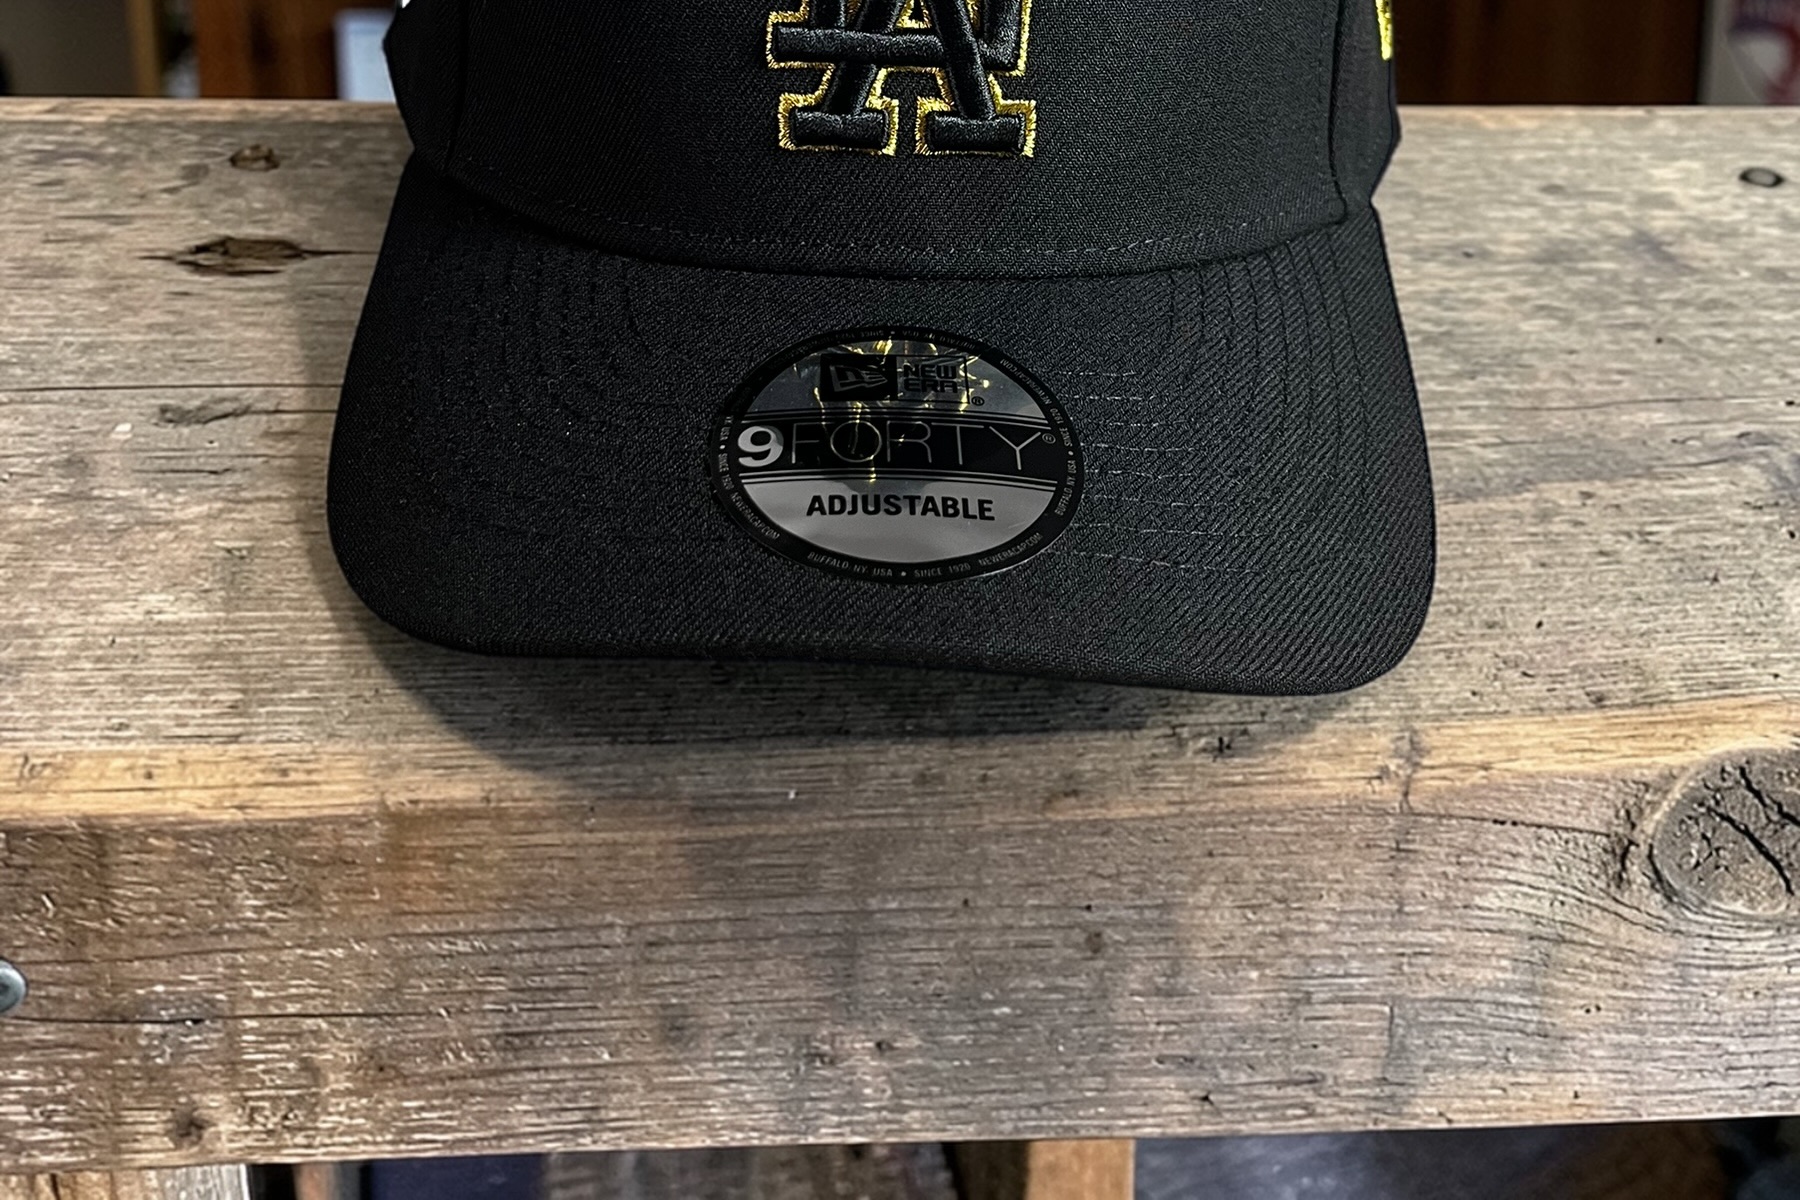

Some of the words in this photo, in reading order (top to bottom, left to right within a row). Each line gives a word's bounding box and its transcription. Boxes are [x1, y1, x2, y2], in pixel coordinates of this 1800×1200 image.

[903, 364, 957, 379] NEW
[903, 378, 958, 394] ERA
[806, 493, 995, 521] ADJUSTABLE
[873, 567, 893, 577] USA
[914, 567, 942, 578] SINCE
[948, 562, 972, 574] 1920
